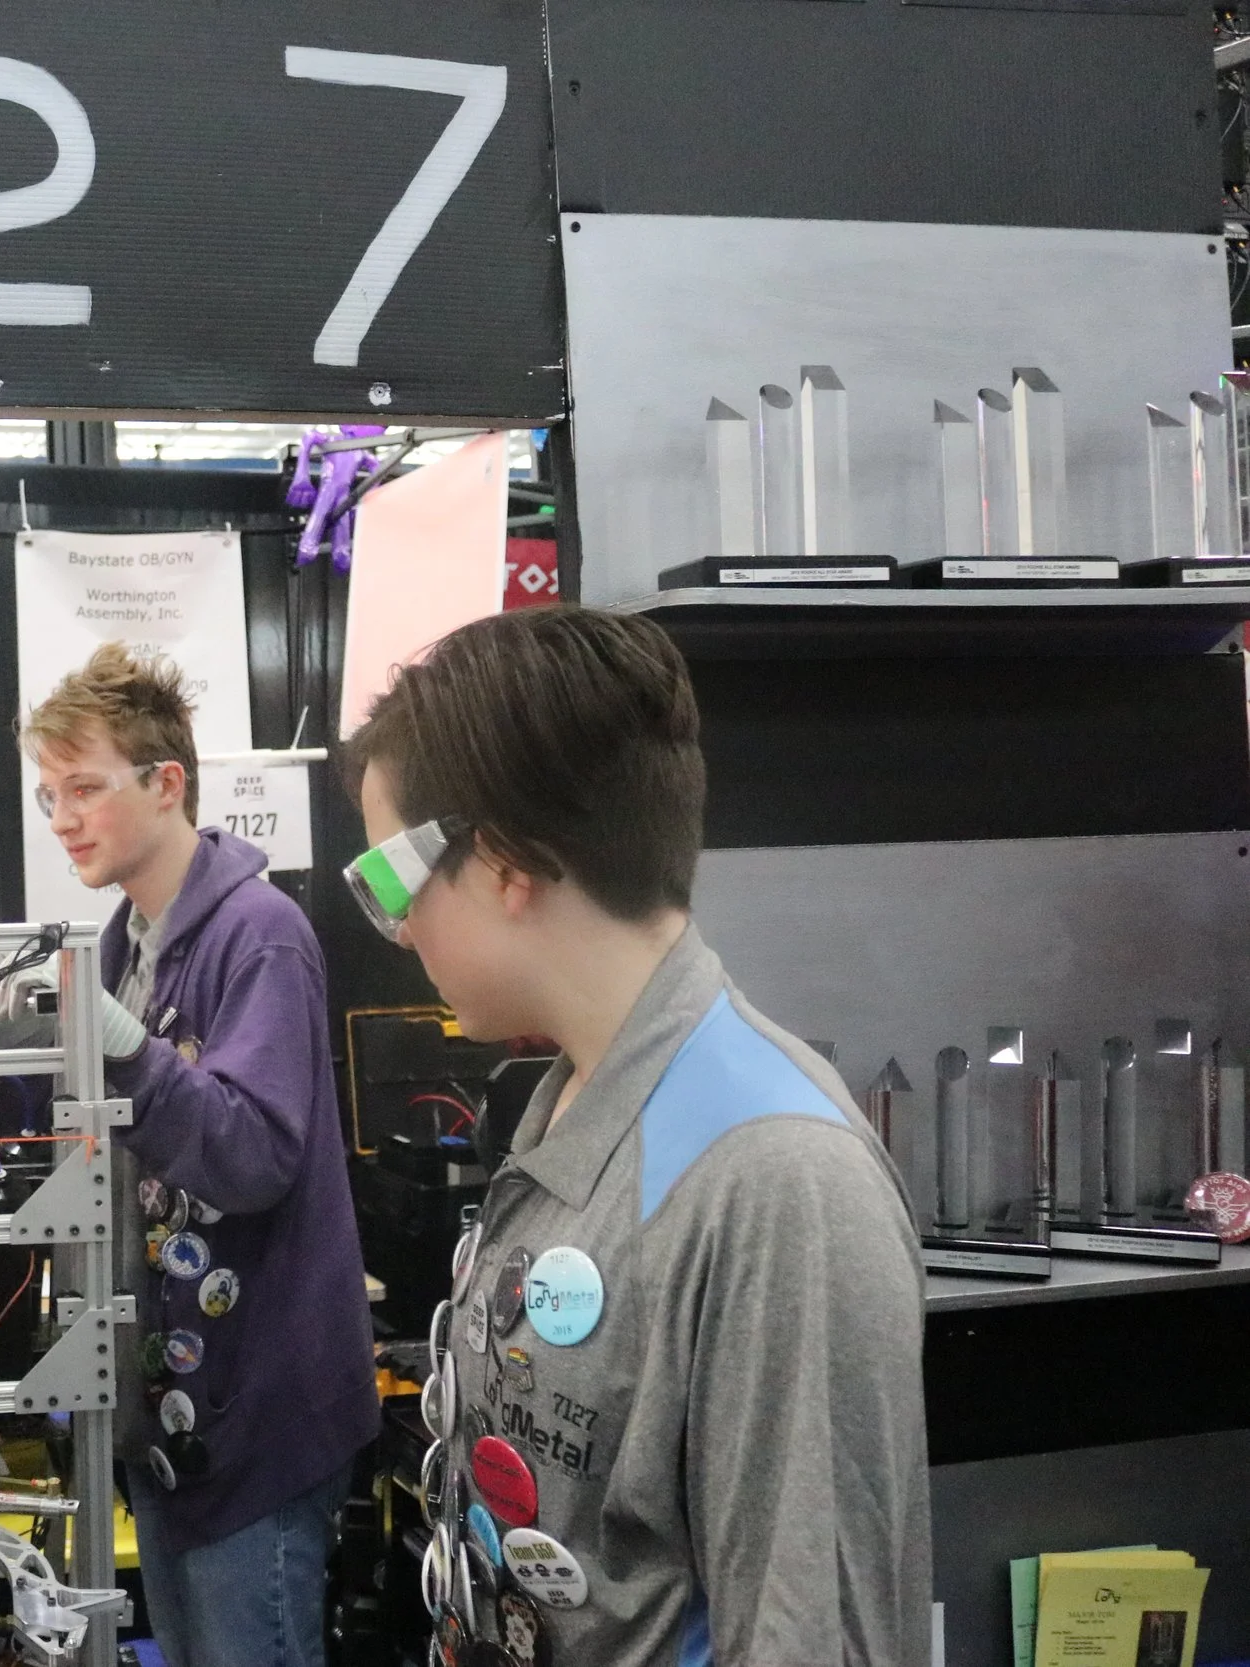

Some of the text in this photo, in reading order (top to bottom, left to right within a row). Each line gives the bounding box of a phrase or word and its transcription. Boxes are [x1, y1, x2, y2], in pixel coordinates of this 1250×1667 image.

[68, 551, 194, 567] Baystate OB/GYN
[87, 588, 177, 604] Worthington
[76, 606, 184, 621] Assembly, Inc.
[225, 812, 278, 838] 7127
[552, 1324, 573, 1336] 2018
[553, 1391, 600, 1431] 7127
